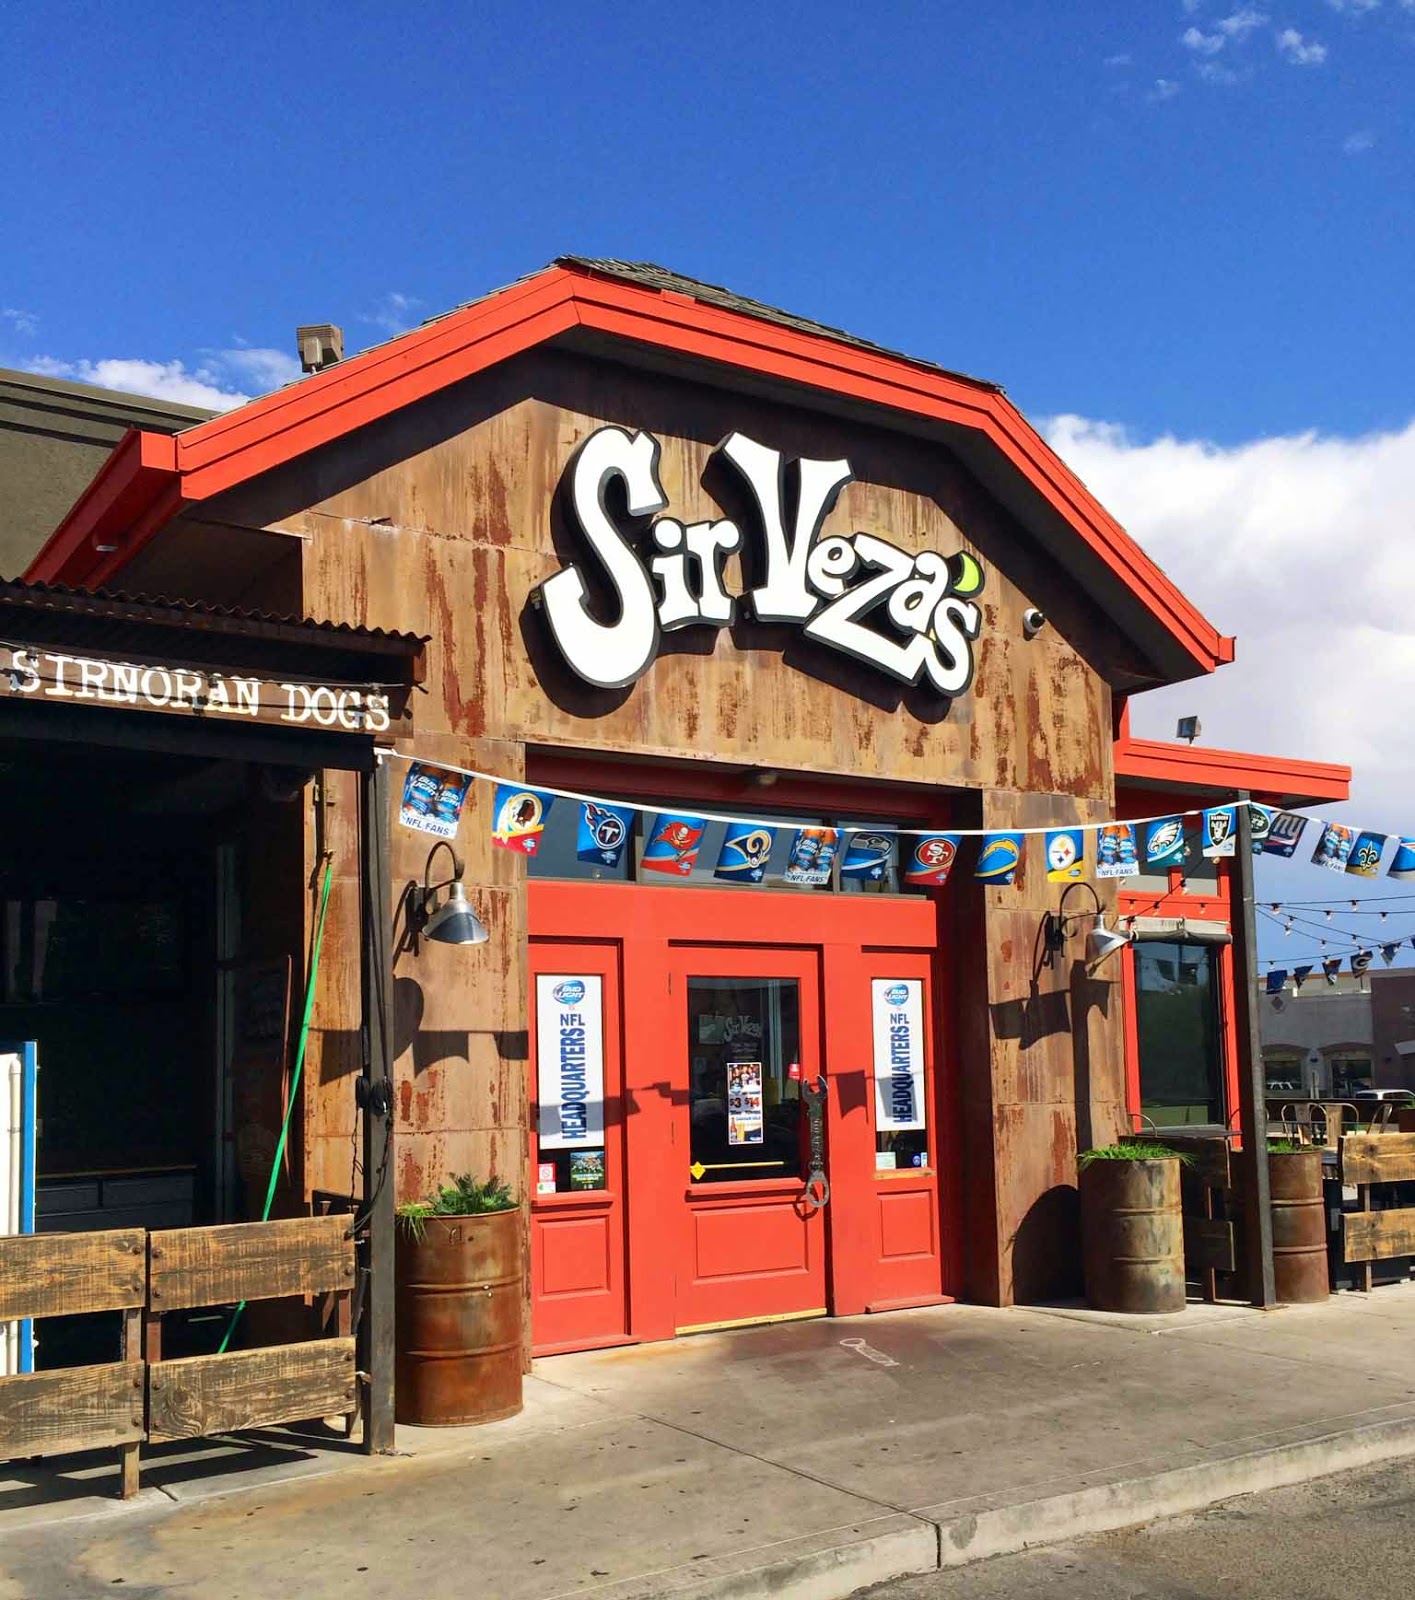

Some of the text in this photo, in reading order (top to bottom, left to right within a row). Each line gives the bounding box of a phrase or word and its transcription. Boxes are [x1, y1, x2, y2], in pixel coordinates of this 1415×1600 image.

[541, 426, 982, 697] Sir Veza's
[9, 650, 391, 732] SIRNORAN DOGS
[406, 817, 450, 836] NFL FANS
[560, 1013, 586, 1026] NFL
[890, 1013, 910, 1024] NFL
[560, 1027, 590, 1139] HEADQUARTERS
[890, 1025, 915, 1123] HEADQUARTERS
